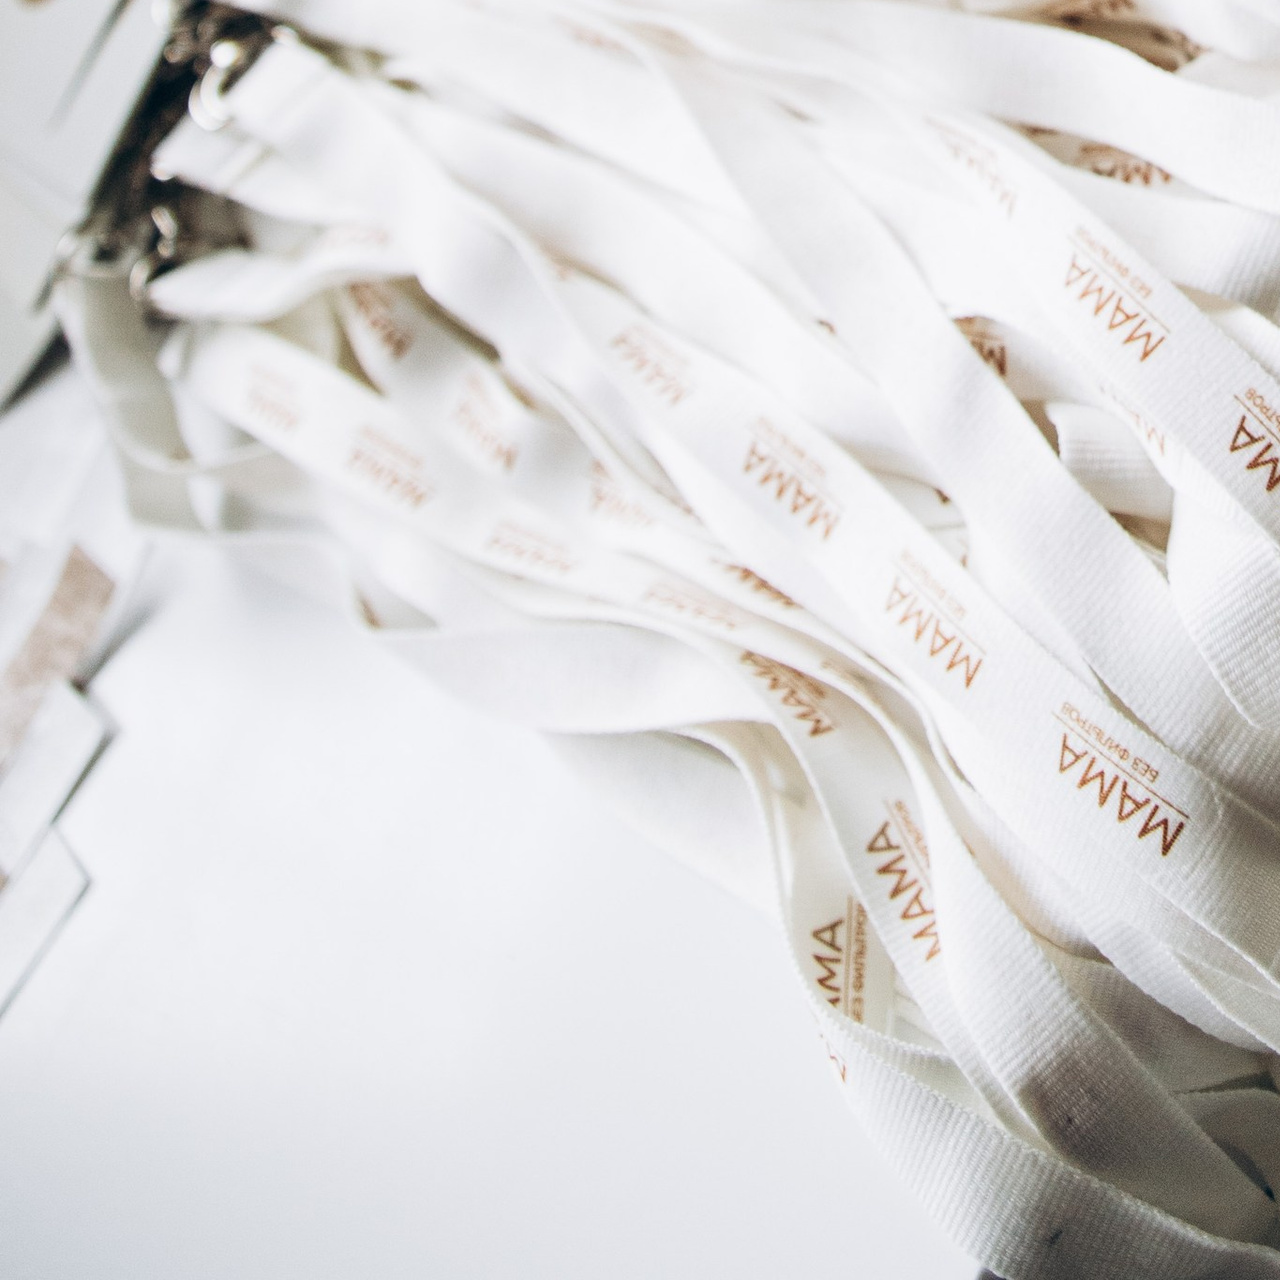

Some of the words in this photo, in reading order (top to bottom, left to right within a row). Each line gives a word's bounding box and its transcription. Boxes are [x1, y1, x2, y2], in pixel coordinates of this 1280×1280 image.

[1065, 253, 1165, 363] МАМА
[744, 441, 840, 541] МАМА
[886, 575, 984, 689] МАМА
[1061, 701, 1130, 761] ФИЛЬТРОВ
[1130, 757, 1160, 784] БЕЗ
[1058, 732, 1186, 856] МАМА
